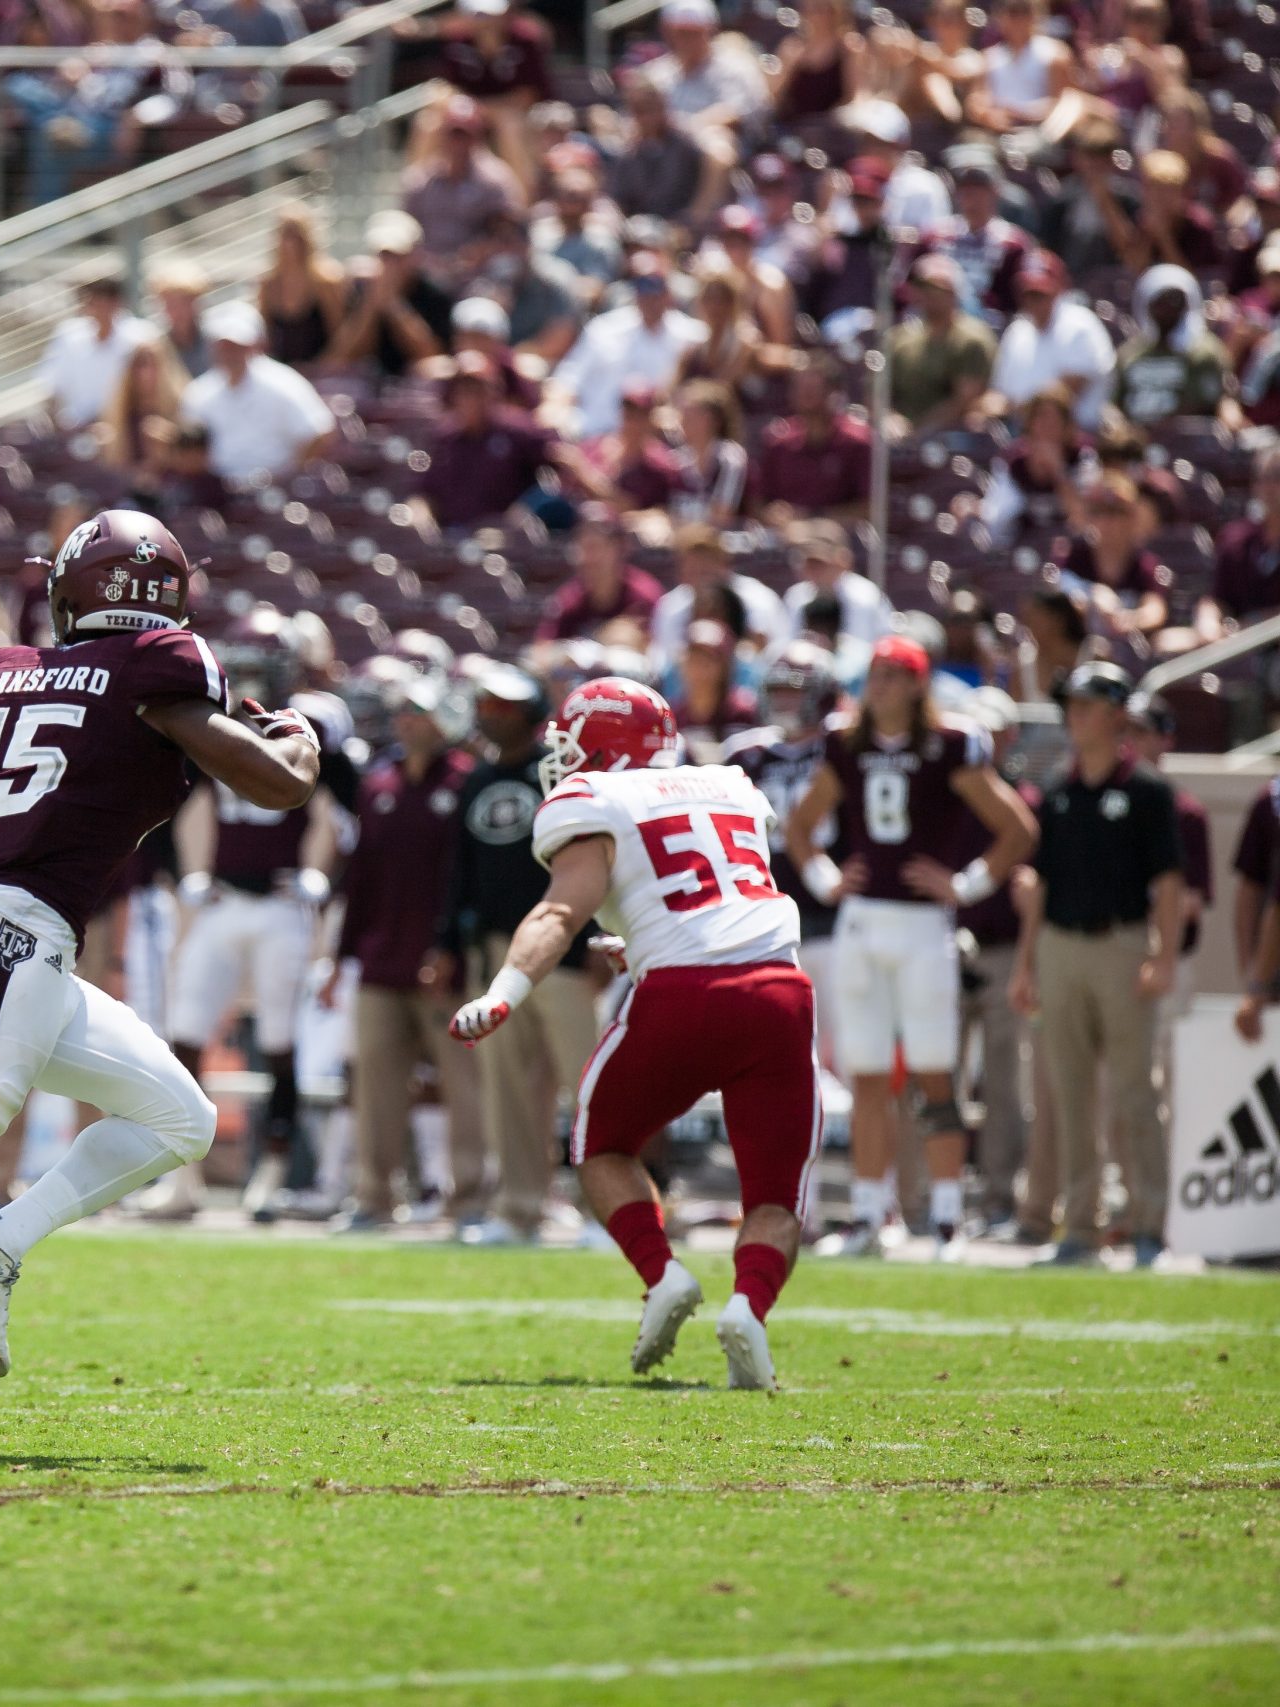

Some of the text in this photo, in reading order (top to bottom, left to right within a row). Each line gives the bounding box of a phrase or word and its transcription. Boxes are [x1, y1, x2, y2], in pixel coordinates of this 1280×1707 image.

[105, 614, 169, 630] TEXAS A&M
[864, 773, 911, 844] 8
[636, 812, 786, 912] 55
[1181, 1152, 1280, 1210] adid
